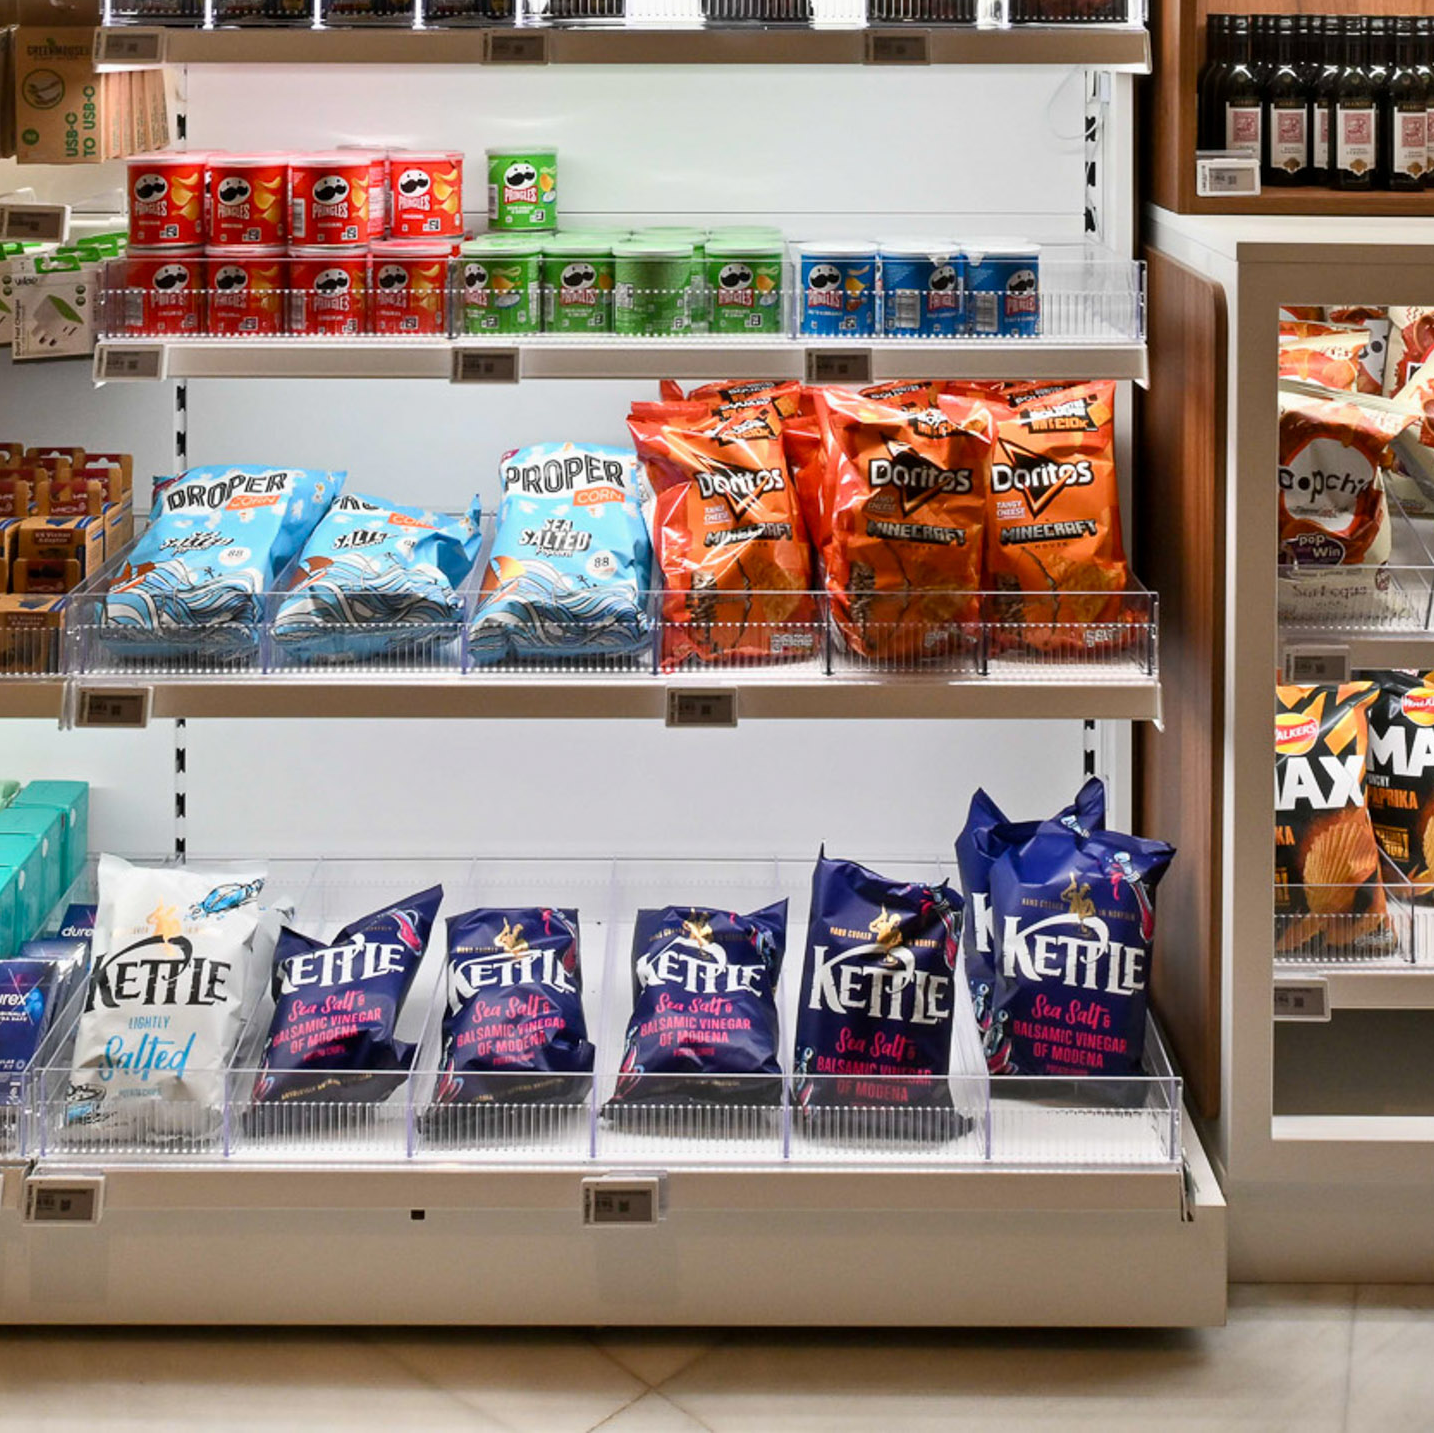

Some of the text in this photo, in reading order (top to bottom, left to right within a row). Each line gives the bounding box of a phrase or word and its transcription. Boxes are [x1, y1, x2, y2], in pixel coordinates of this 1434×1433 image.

[134, 200, 168, 218] PRINGLES
[217, 203, 250, 220] PRINGLES
[504, 454, 625, 494] PROPER
[696, 468, 785, 499] Doritos
[870, 459, 972, 492] Doritos
[992, 461, 1093, 492] Doritos
[230, 495, 277, 507] CORN
[577, 489, 621, 504] CORN
[996, 501, 1022, 509] TANGY
[996, 508, 1026, 516] CHEESE
[543, 519, 573, 531] SEA
[867, 521, 966, 545] MINECRAFT
[1000, 520, 1098, 545] MINECRAFT
[519, 530, 592, 551] SALTED
[1299, 535, 1325, 546] pop
[1312, 547, 1341, 558] Win
[594, 557, 609, 568] 88
[1003, 913, 1146, 995] KETTLE
[84, 935, 231, 1012] KETTLE
[636, 936, 766, 997] KETTLE
[808, 943, 951, 1025] KETTLE
[288, 991, 359, 1021] Sea Salt
[471, 994, 541, 1023] Sea Salt
[655, 993, 724, 1014] Sea Salt
[128, 1015, 172, 1030] LIGHTLY
[273, 1008, 381, 1047] BALSAMIC VINEGAR
[457, 1022, 516, 1047] BALSAMIC
[640, 1018, 752, 1037] BALSAMIC VINEGAR
[290, 1026, 358, 1053] OF MODENA
[477, 1031, 546, 1056] OF MODENA
[659, 1031, 730, 1047] OF MODENA
[835, 1027, 909, 1062] Sea Salt
[98, 1032, 197, 1082] Salted
[817, 1055, 877, 1074] BALSAMIC
[855, 1082, 909, 1102] MODENA
